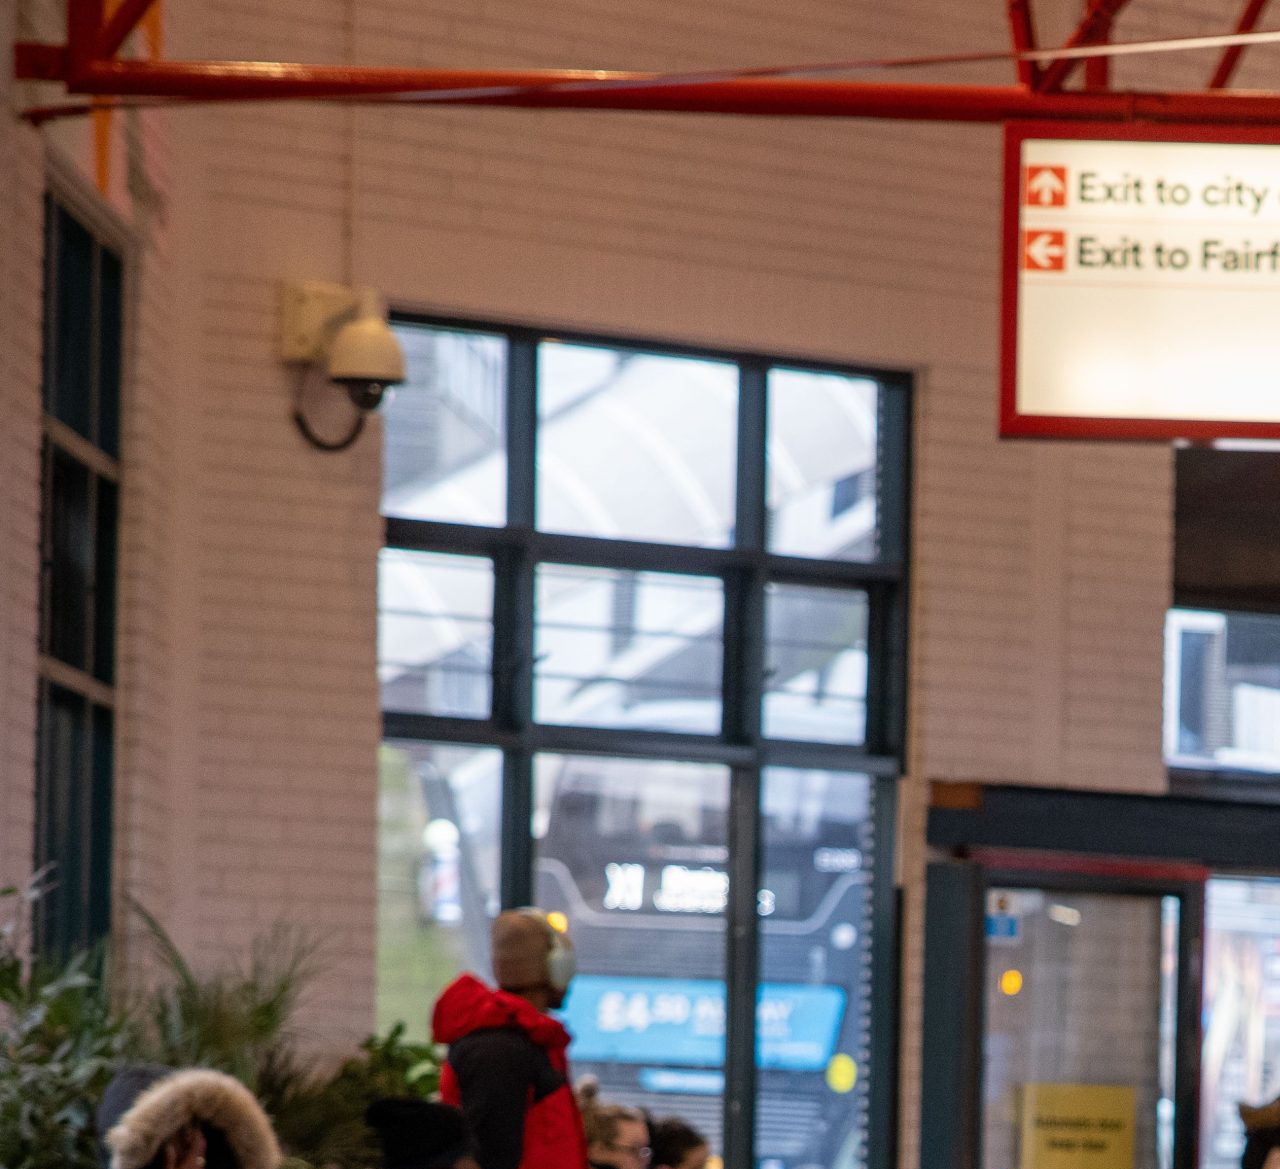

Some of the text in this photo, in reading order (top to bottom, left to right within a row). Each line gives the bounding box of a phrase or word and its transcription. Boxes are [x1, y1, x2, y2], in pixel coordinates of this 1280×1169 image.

[1078, 172, 1142, 203] Exit
[1156, 178, 1190, 205] to
[1203, 176, 1267, 213] city
[1076, 235, 1143, 269] Exit
[1153, 243, 1190, 270] to
